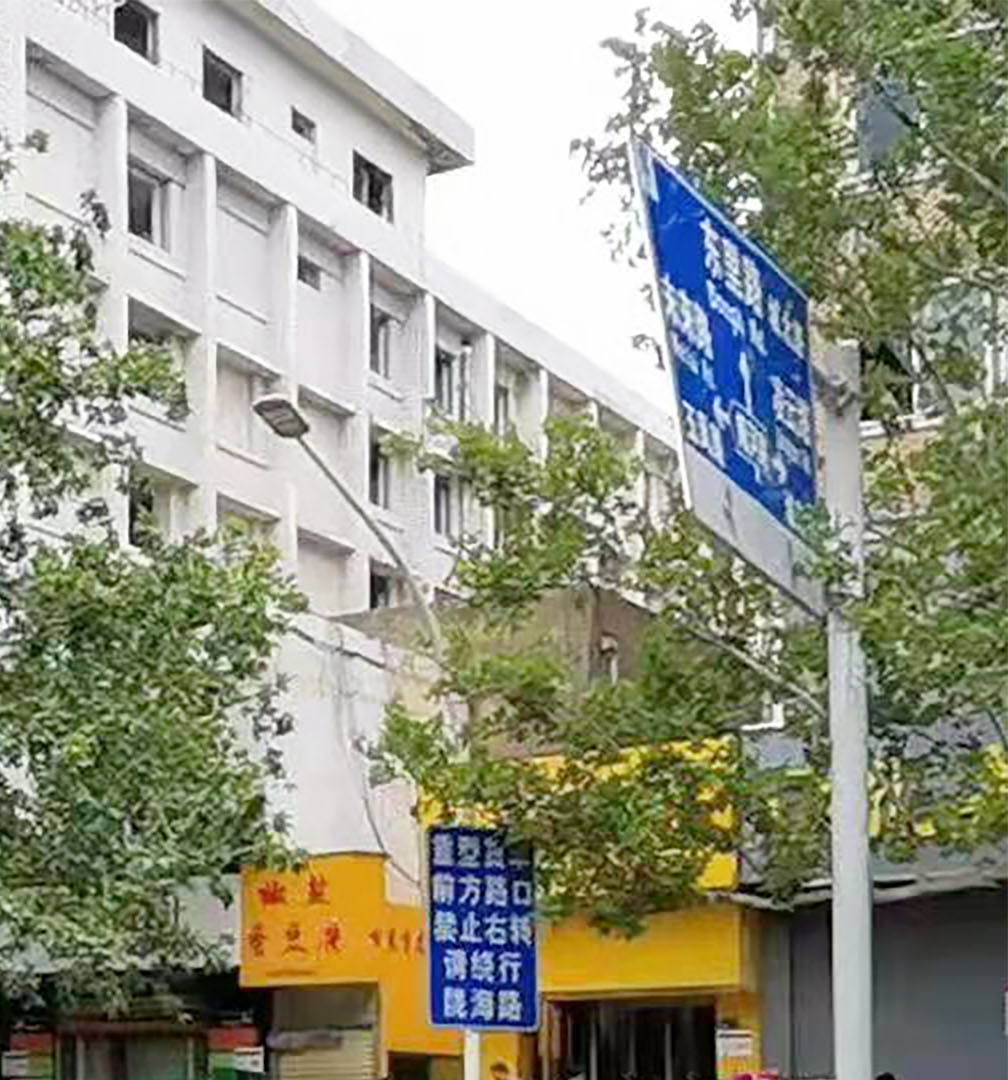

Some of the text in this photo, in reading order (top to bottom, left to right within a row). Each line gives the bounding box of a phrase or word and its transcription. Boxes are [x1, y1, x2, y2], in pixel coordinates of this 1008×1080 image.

[433, 832, 531, 869] 重型货
[432, 874, 532, 906] 前方路口
[434, 910, 532, 946] 禁止右转
[444, 949, 522, 983] 请绕行
[444, 985, 522, 1021] 陇海路
